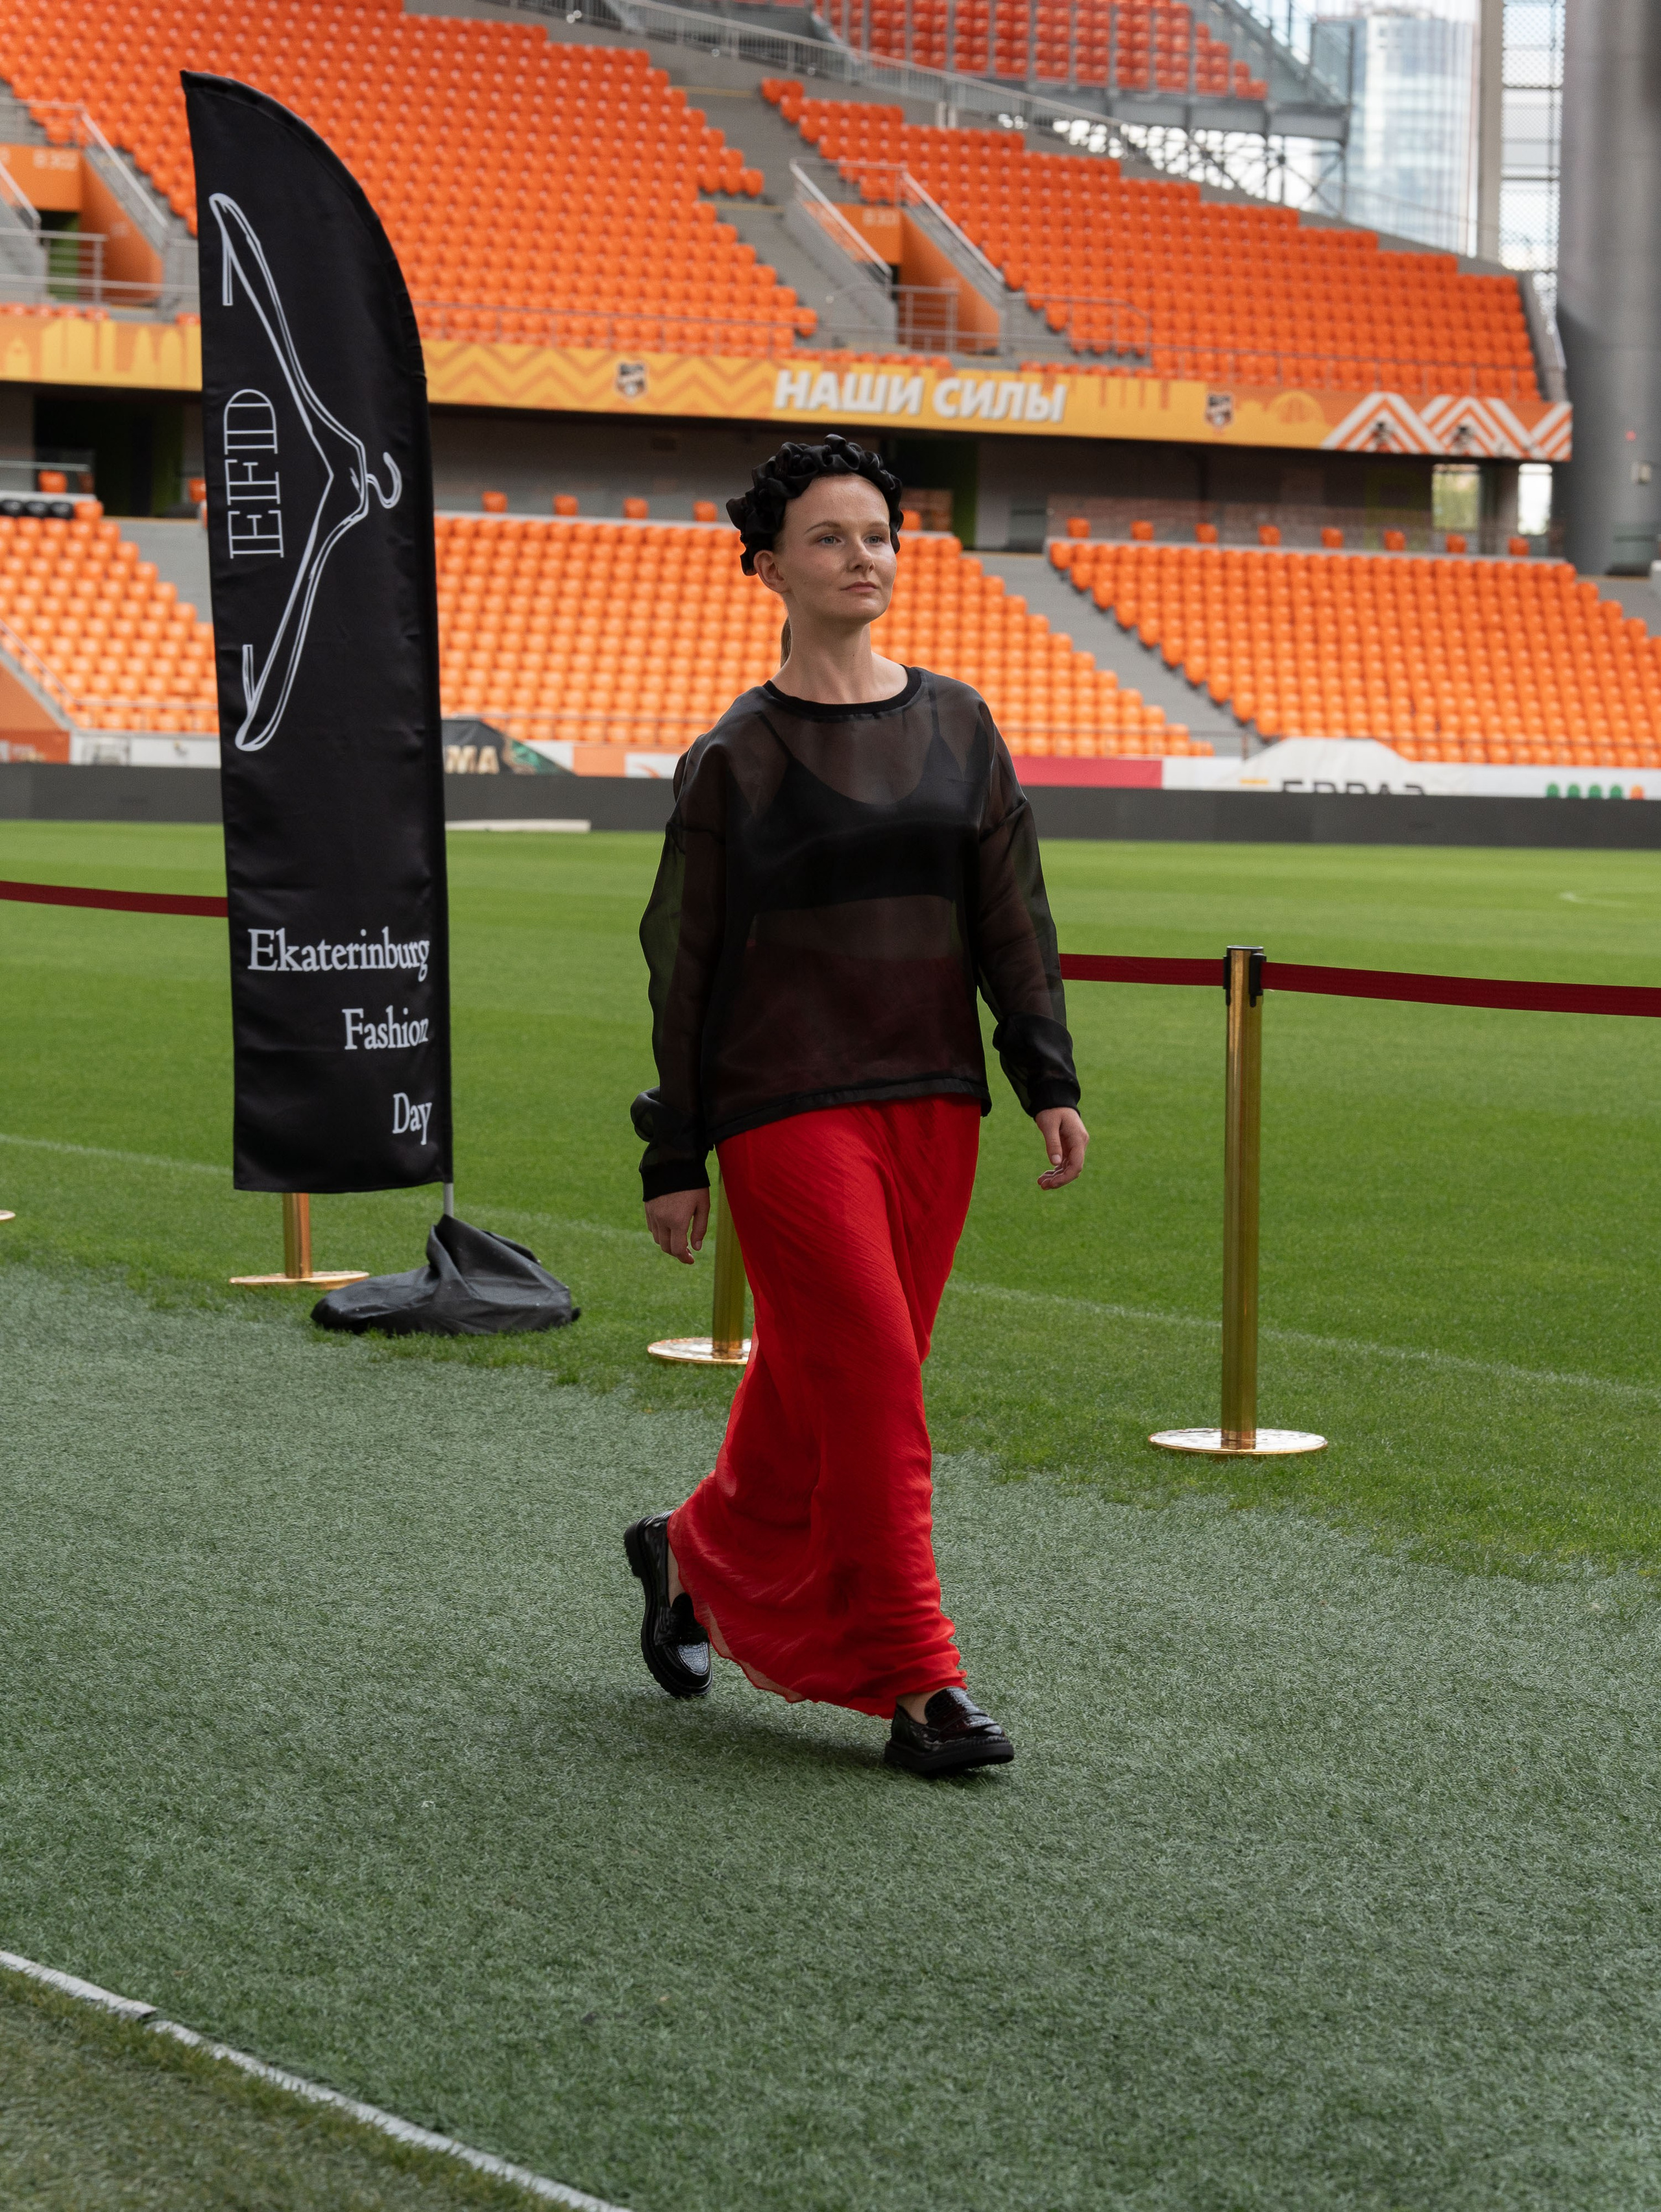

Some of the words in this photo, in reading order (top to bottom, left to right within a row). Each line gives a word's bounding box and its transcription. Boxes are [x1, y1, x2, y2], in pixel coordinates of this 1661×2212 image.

[773, 369, 926, 415] НАШИ
[932, 377, 1067, 422] СИЛЫ
[223, 389, 284, 559] EFD
[247, 926, 430, 982] Ekaterinburg
[342, 1005, 429, 1050] Fashion
[392, 1092, 432, 1146] Day
